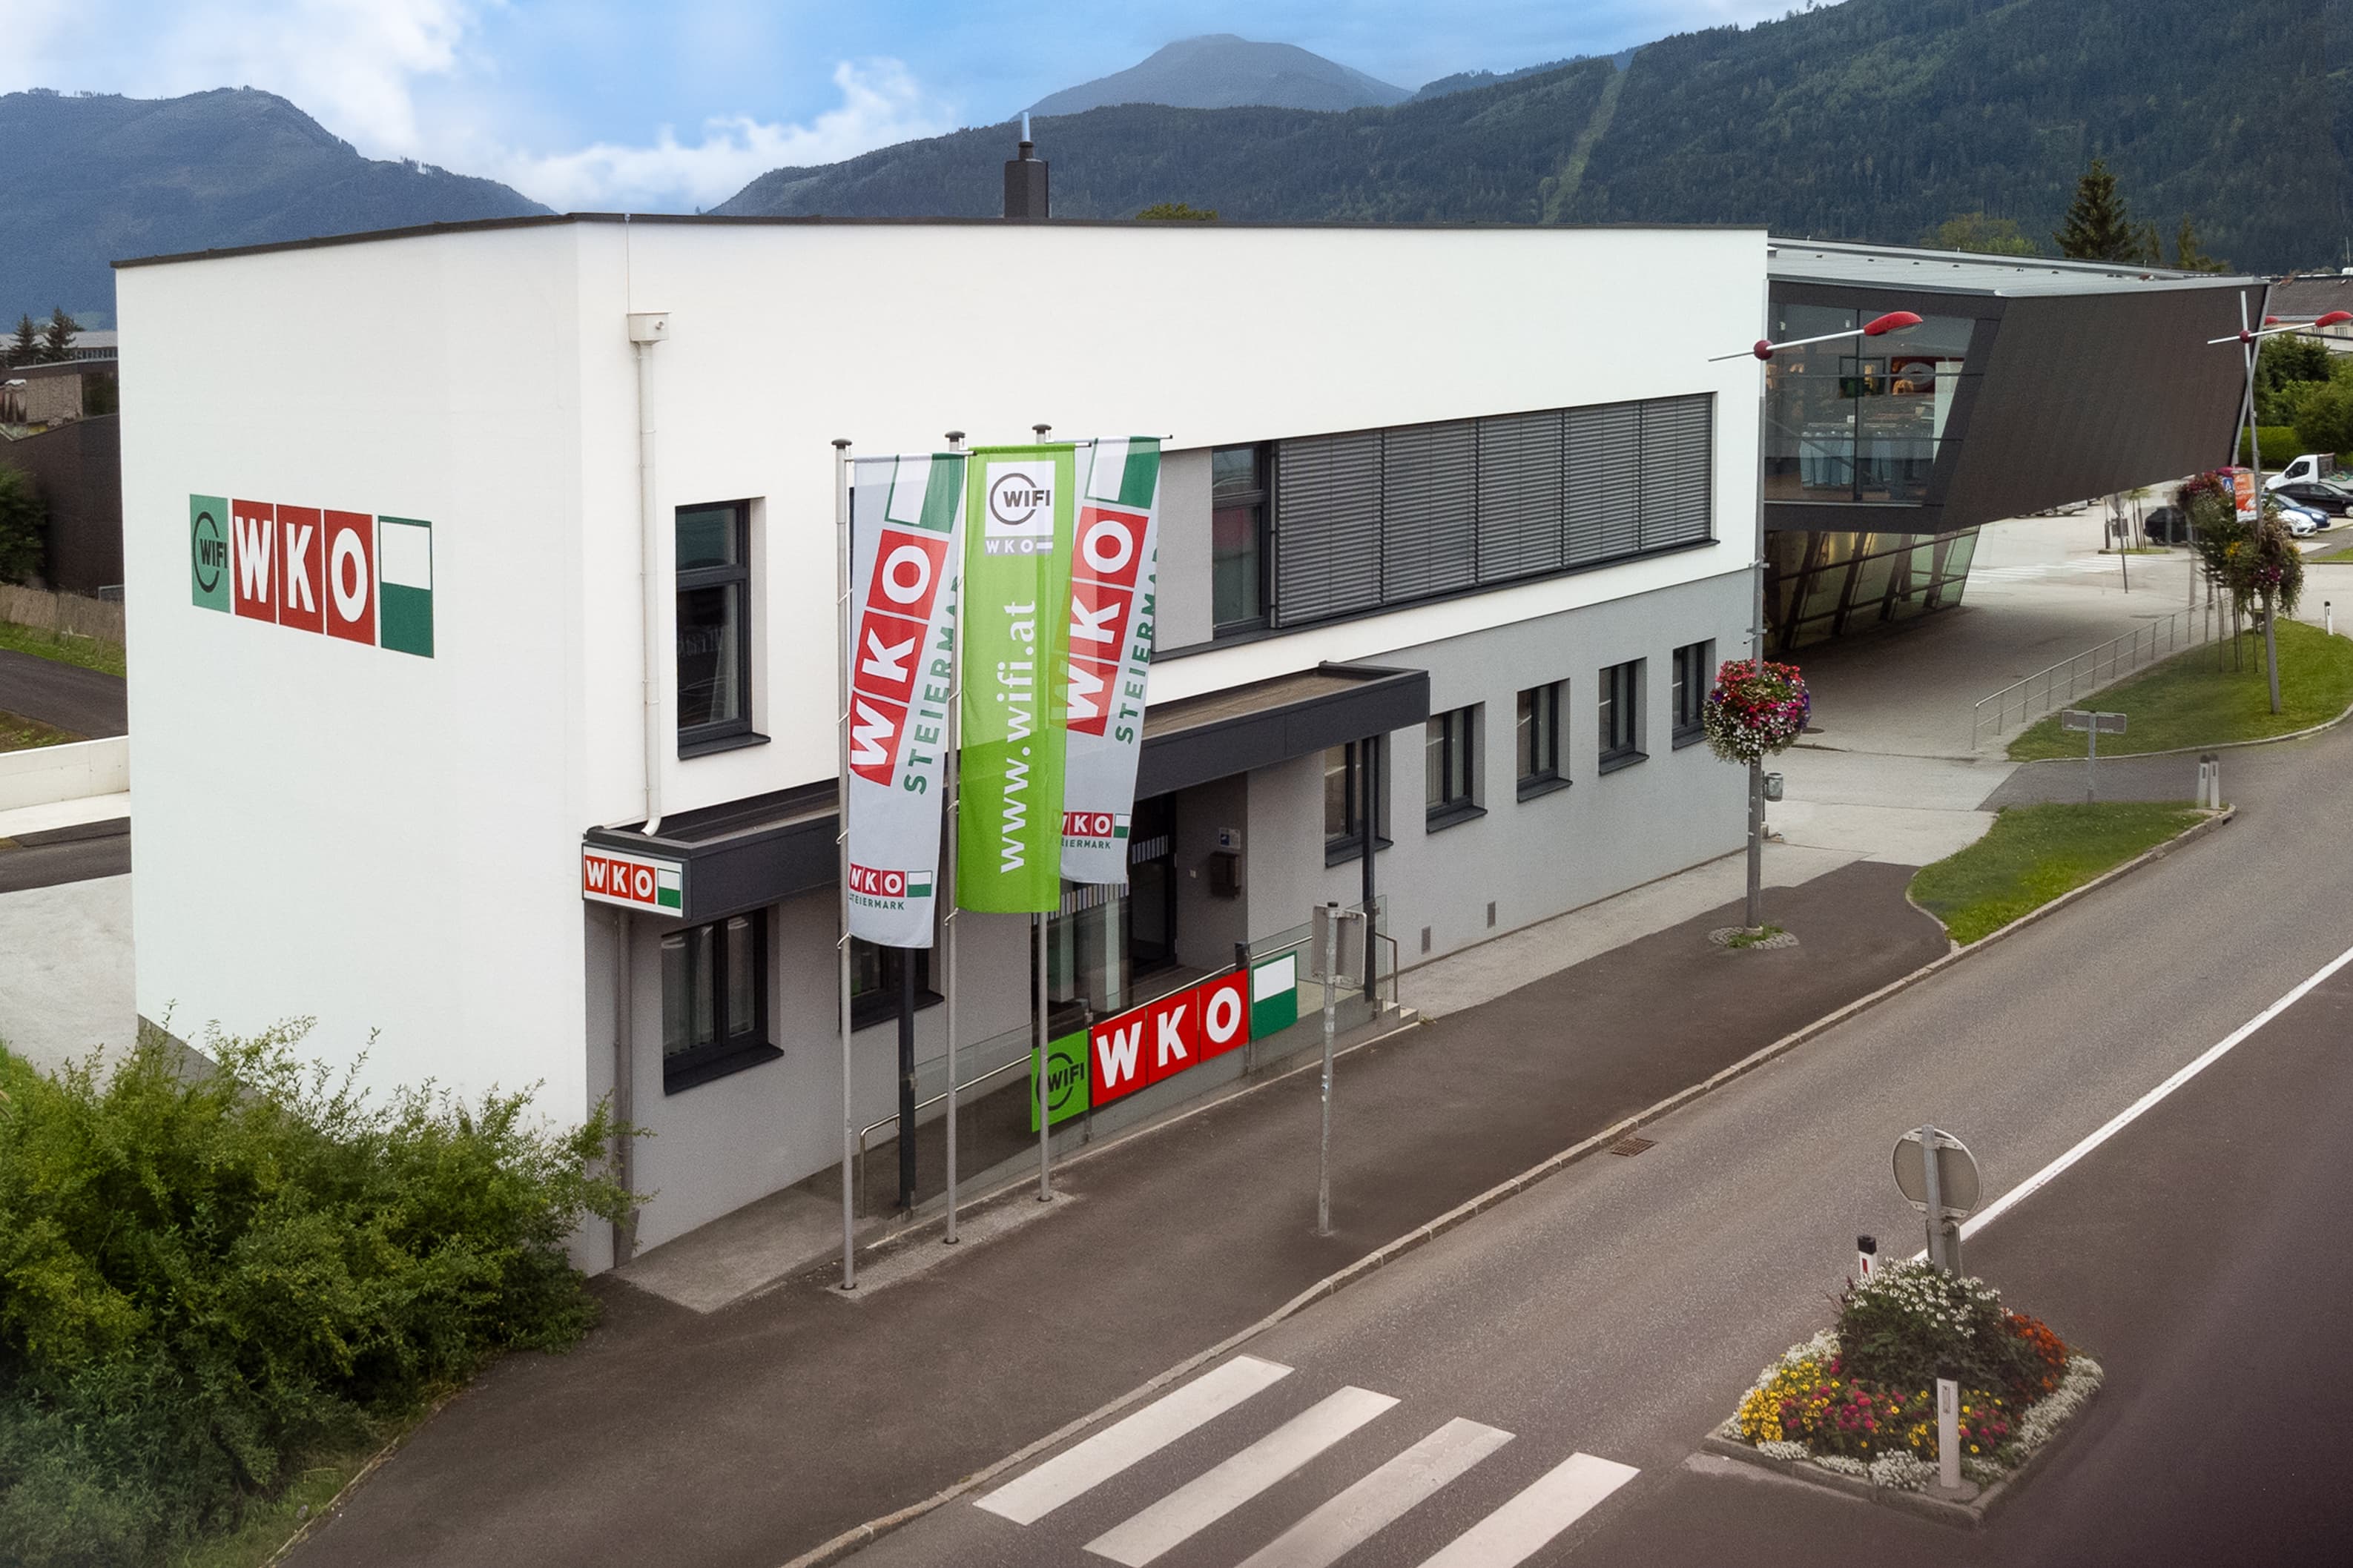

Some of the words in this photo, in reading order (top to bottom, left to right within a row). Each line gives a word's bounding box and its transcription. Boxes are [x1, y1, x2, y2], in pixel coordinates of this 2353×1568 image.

[986, 539, 1034, 553] WKO
[1003, 490, 1050, 507] WIFI
[199, 538, 228, 569] WIFI
[235, 516, 368, 623] WKO
[1060, 520, 1134, 718] WKO
[851, 545, 931, 765] WKO
[997, 601, 1036, 874] www.wifi.at
[1062, 816, 1111, 834] KO
[586, 860, 653, 898] WKO
[1047, 1062, 1084, 1092] WIFI
[1096, 987, 1241, 1088] WKO
